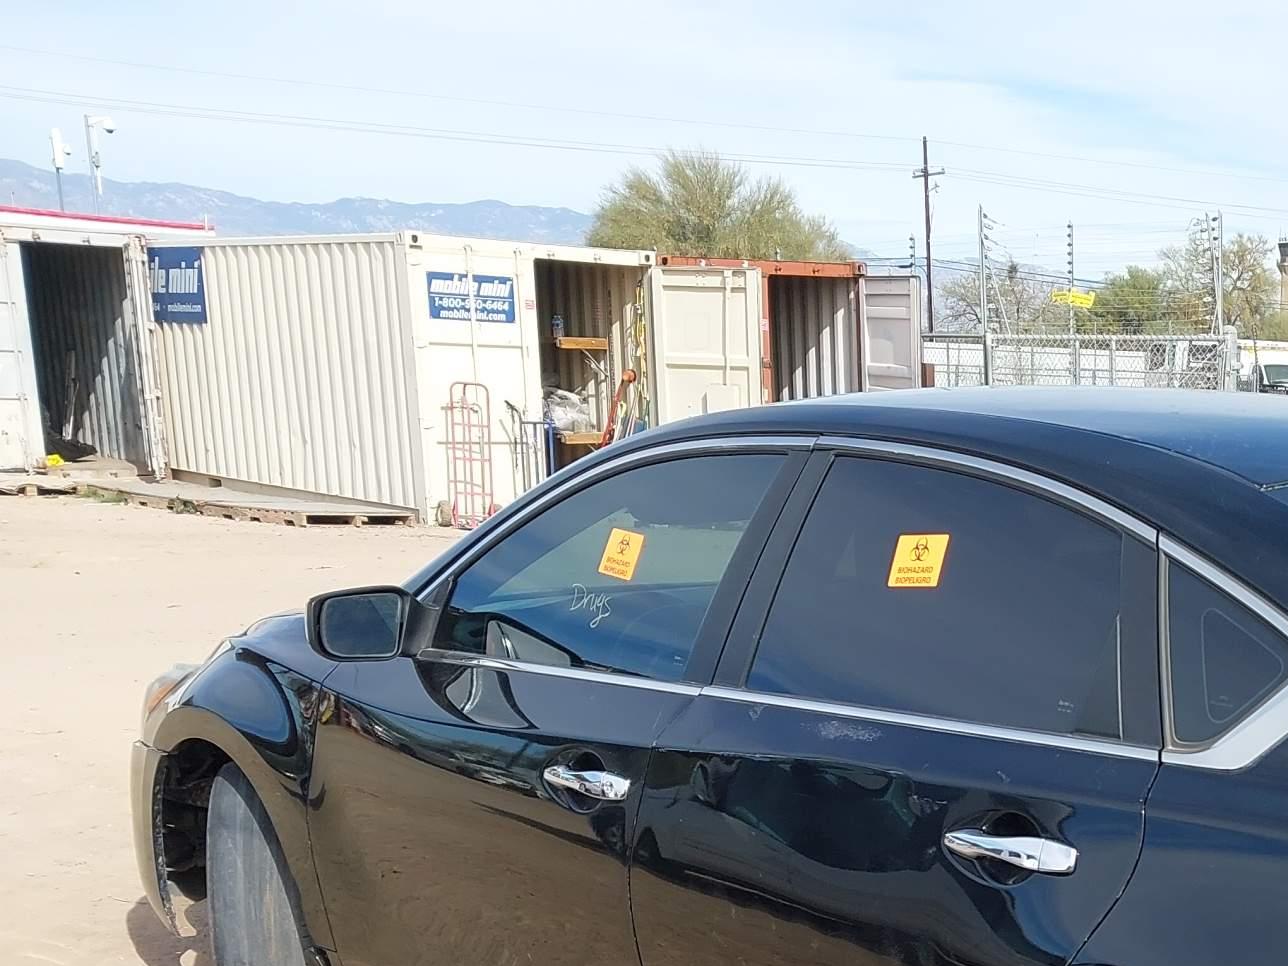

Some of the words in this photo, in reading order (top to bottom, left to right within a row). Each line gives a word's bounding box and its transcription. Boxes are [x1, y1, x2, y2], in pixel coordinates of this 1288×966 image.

[168, 261, 200, 293] mini
[430, 274, 478, 296] mobile
[479, 280, 513, 297] mini
[897, 566, 934, 574] BIOHAZARD
[569, 583, 612, 629] Drugs
